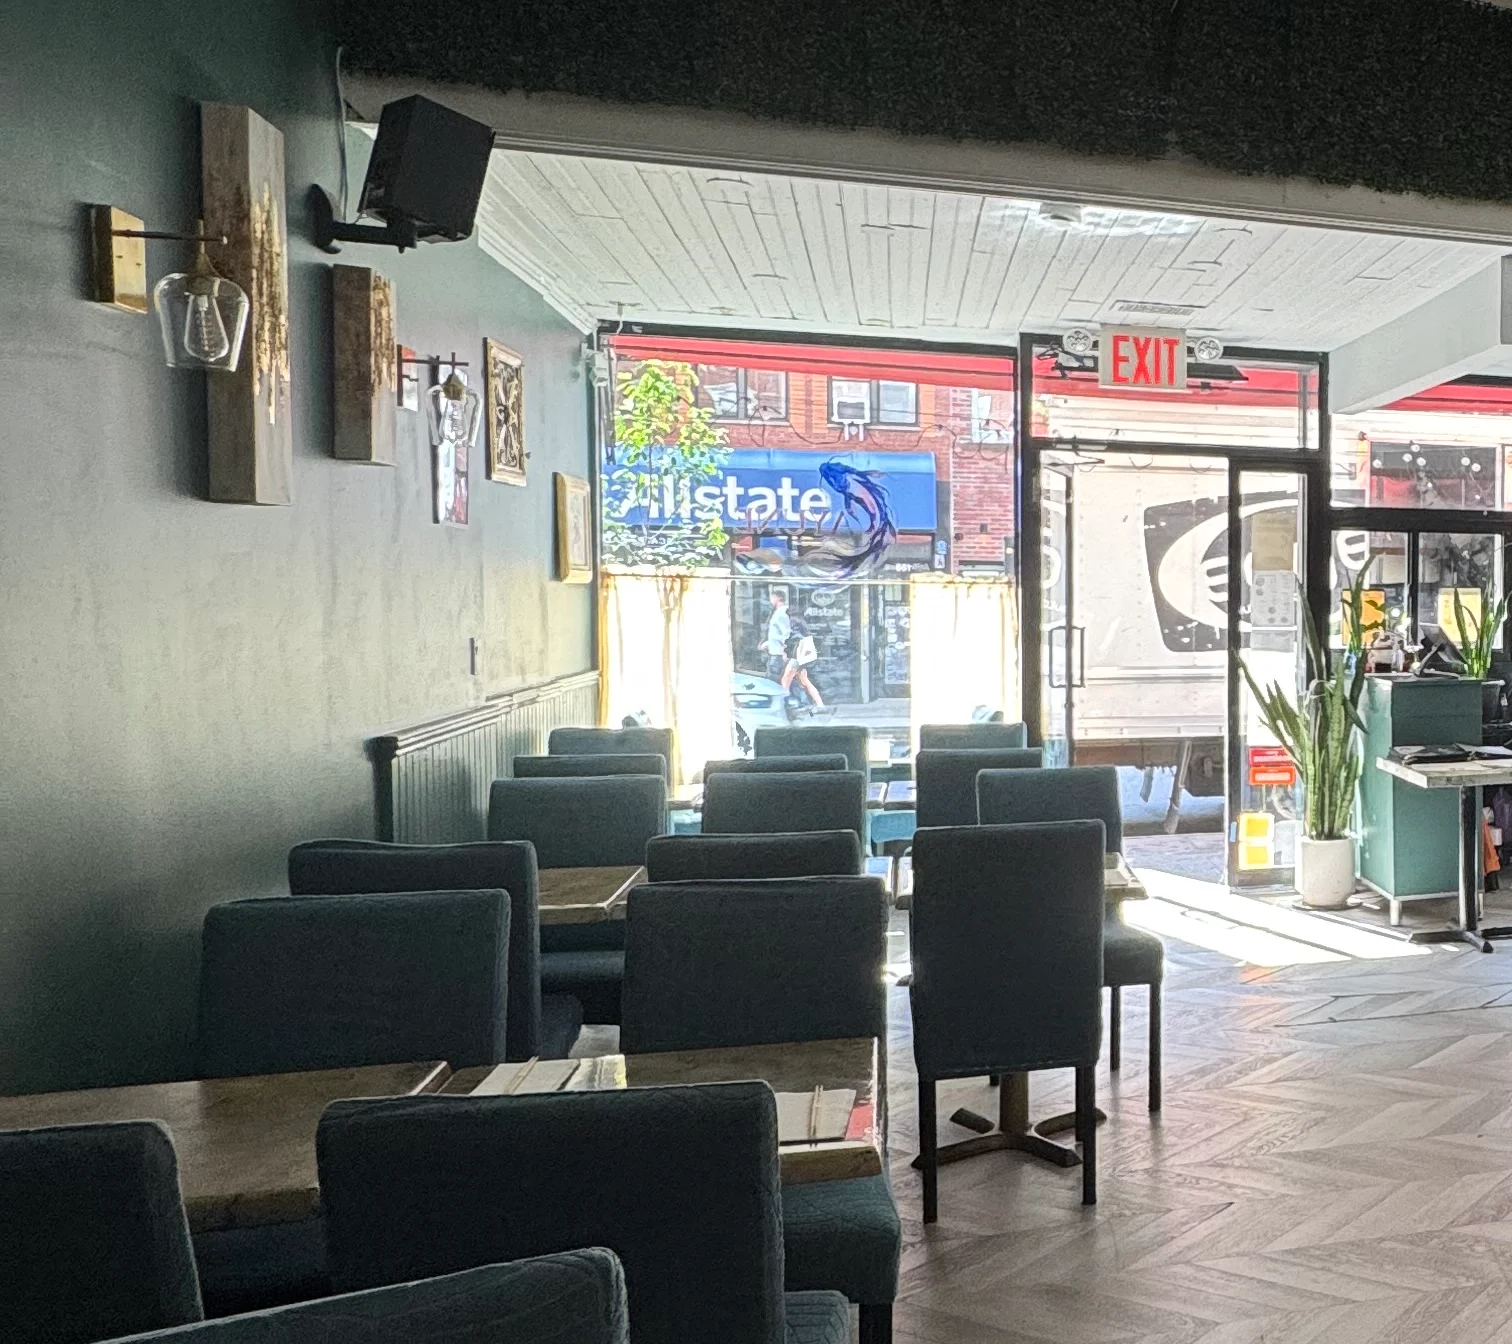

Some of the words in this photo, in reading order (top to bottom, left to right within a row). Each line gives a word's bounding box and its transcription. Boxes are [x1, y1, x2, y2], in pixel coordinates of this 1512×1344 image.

[1112, 334, 1180, 386] EXIT
[611, 473, 832, 523] Allstate
[803, 607, 844, 617] Allstate
